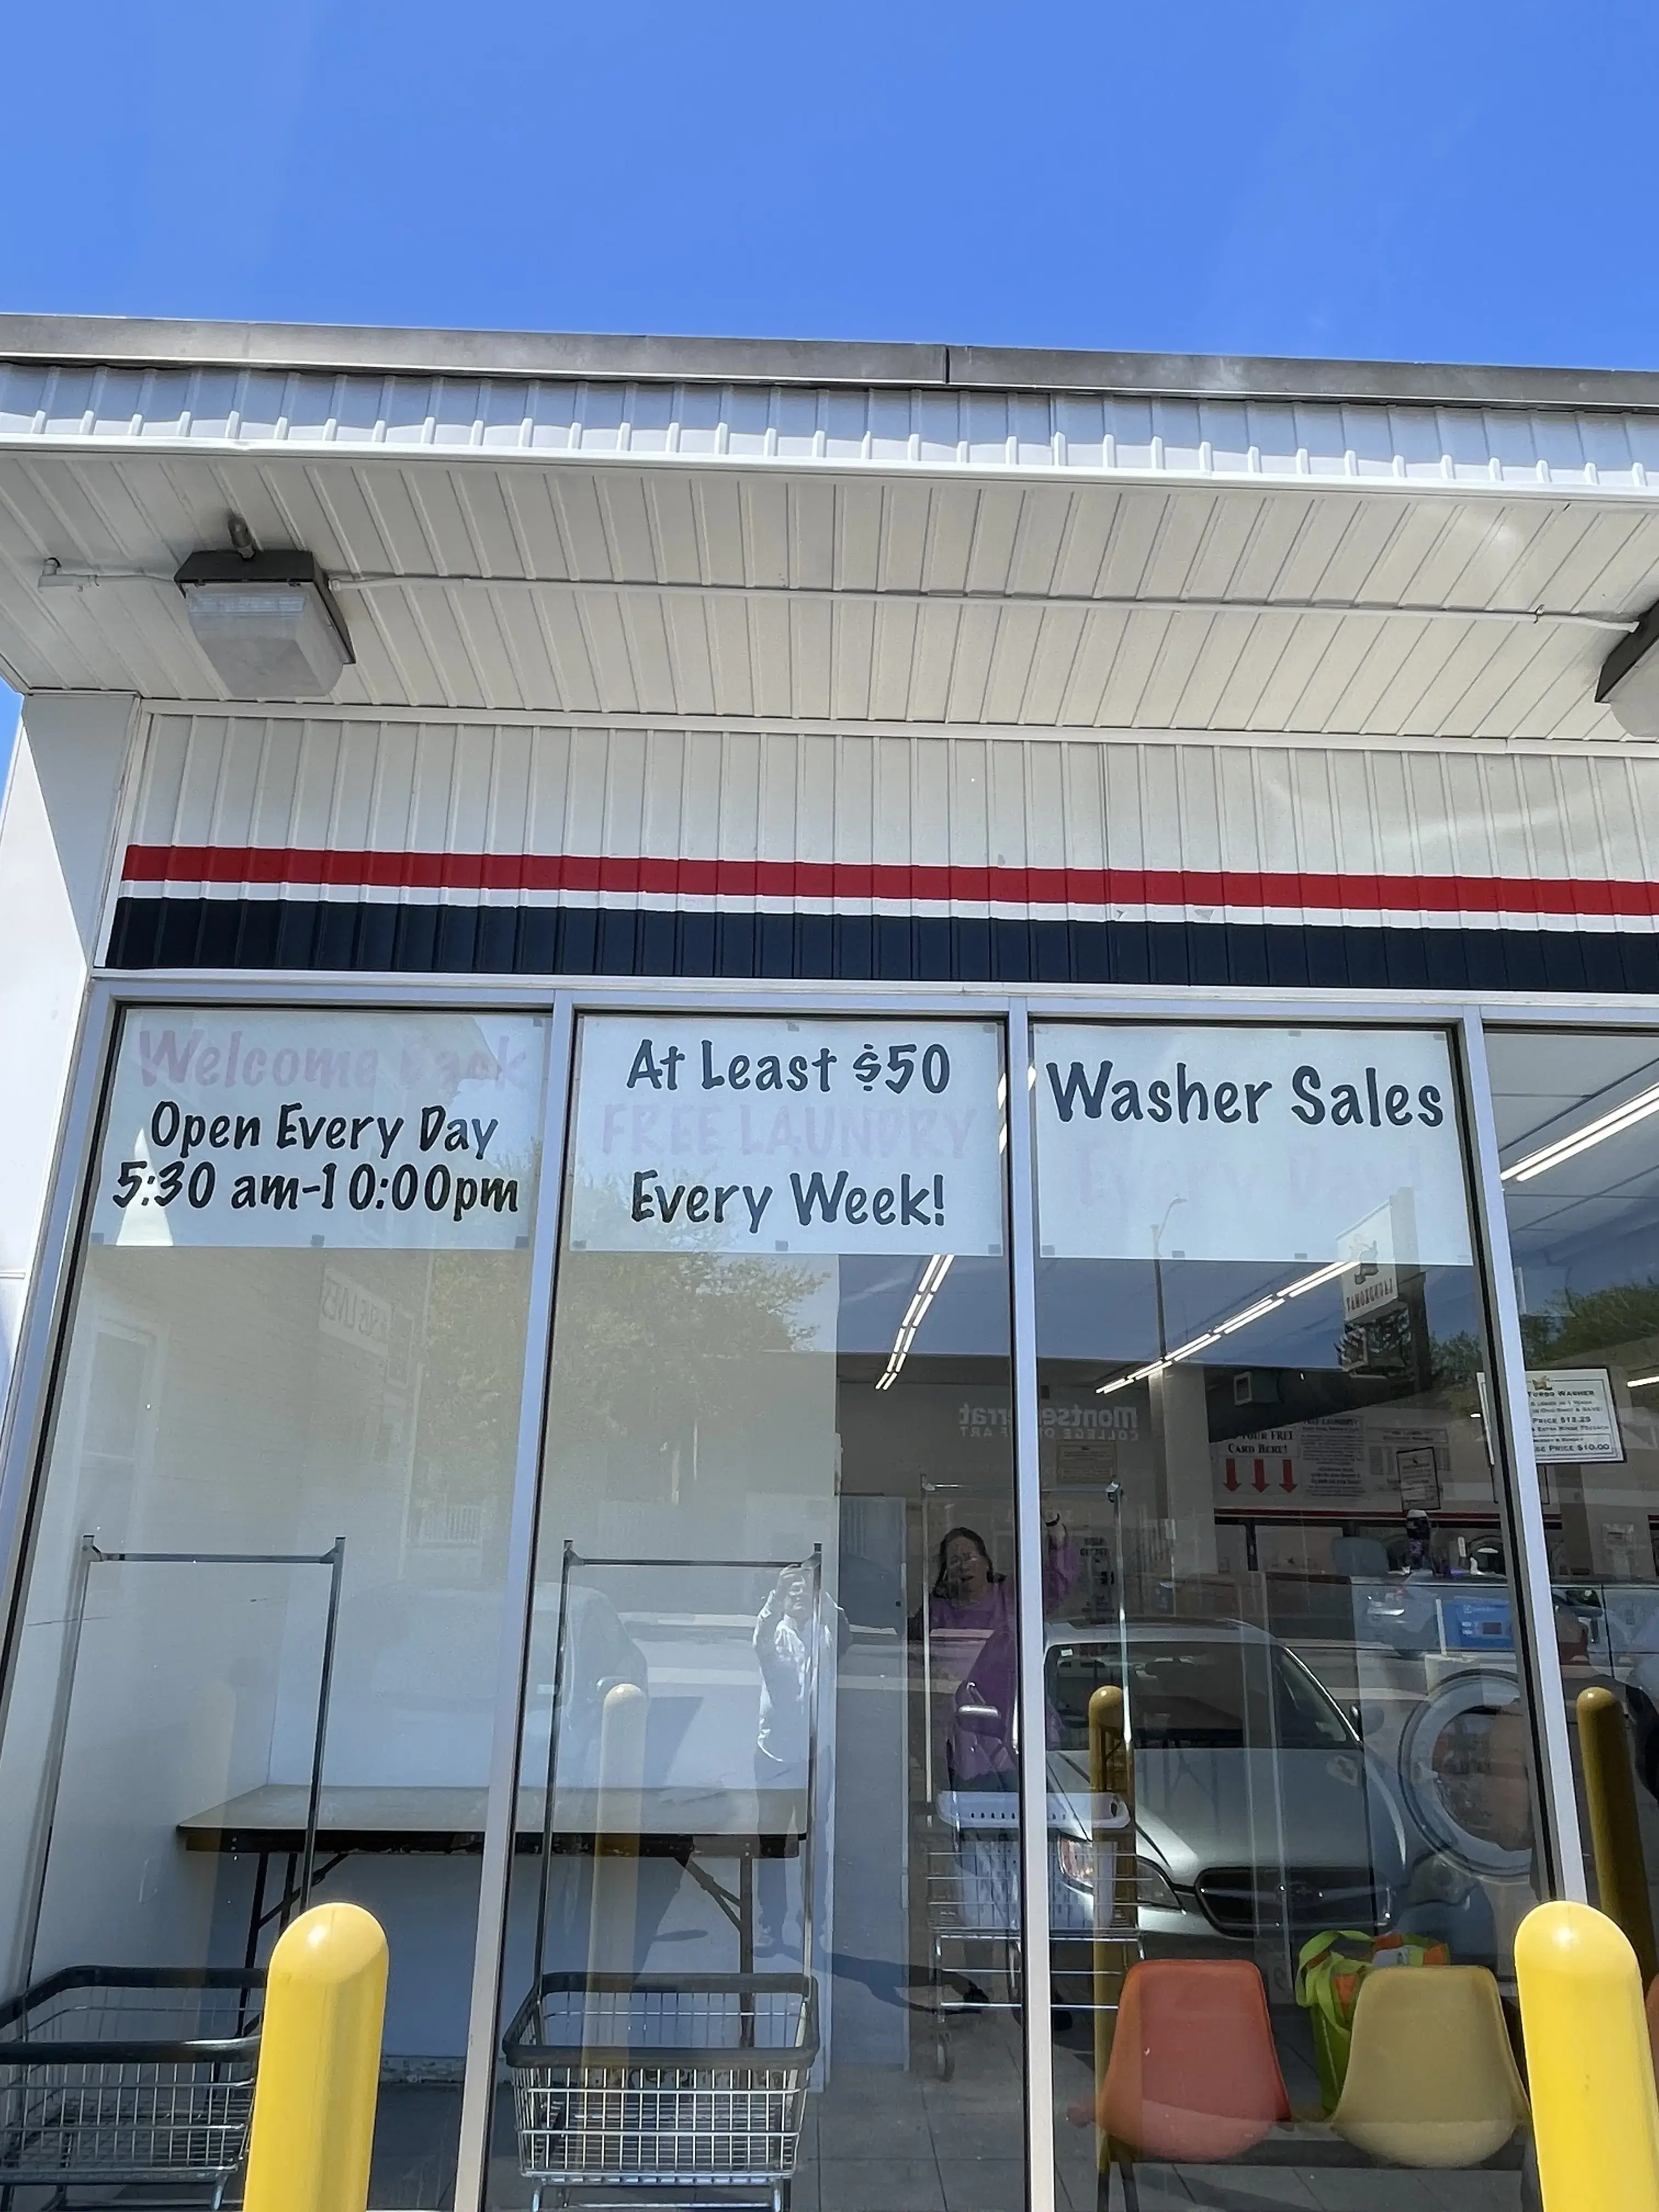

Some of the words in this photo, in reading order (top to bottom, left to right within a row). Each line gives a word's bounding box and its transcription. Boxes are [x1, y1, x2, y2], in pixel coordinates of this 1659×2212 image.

[139, 1030, 379, 1089] Welcome
[627, 1039, 686, 1091] At
[701, 1040, 838, 1093] Least
[853, 1043, 951, 1094] $50
[1046, 1060, 1273, 1124] Washer
[1291, 1065, 1444, 1127] Sales
[151, 1101, 261, 1159] Open
[276, 1102, 404, 1160] Every
[419, 1105, 499, 1160] Day
[601, 1103, 722, 1155] FREE
[739, 1104, 978, 1160] LAUNDRY
[112, 1160, 217, 1210] 5:30
[631, 1169, 774, 1234] Every
[790, 1170, 945, 1227] Week!
[1228, 1442, 1255, 1453] CARD
